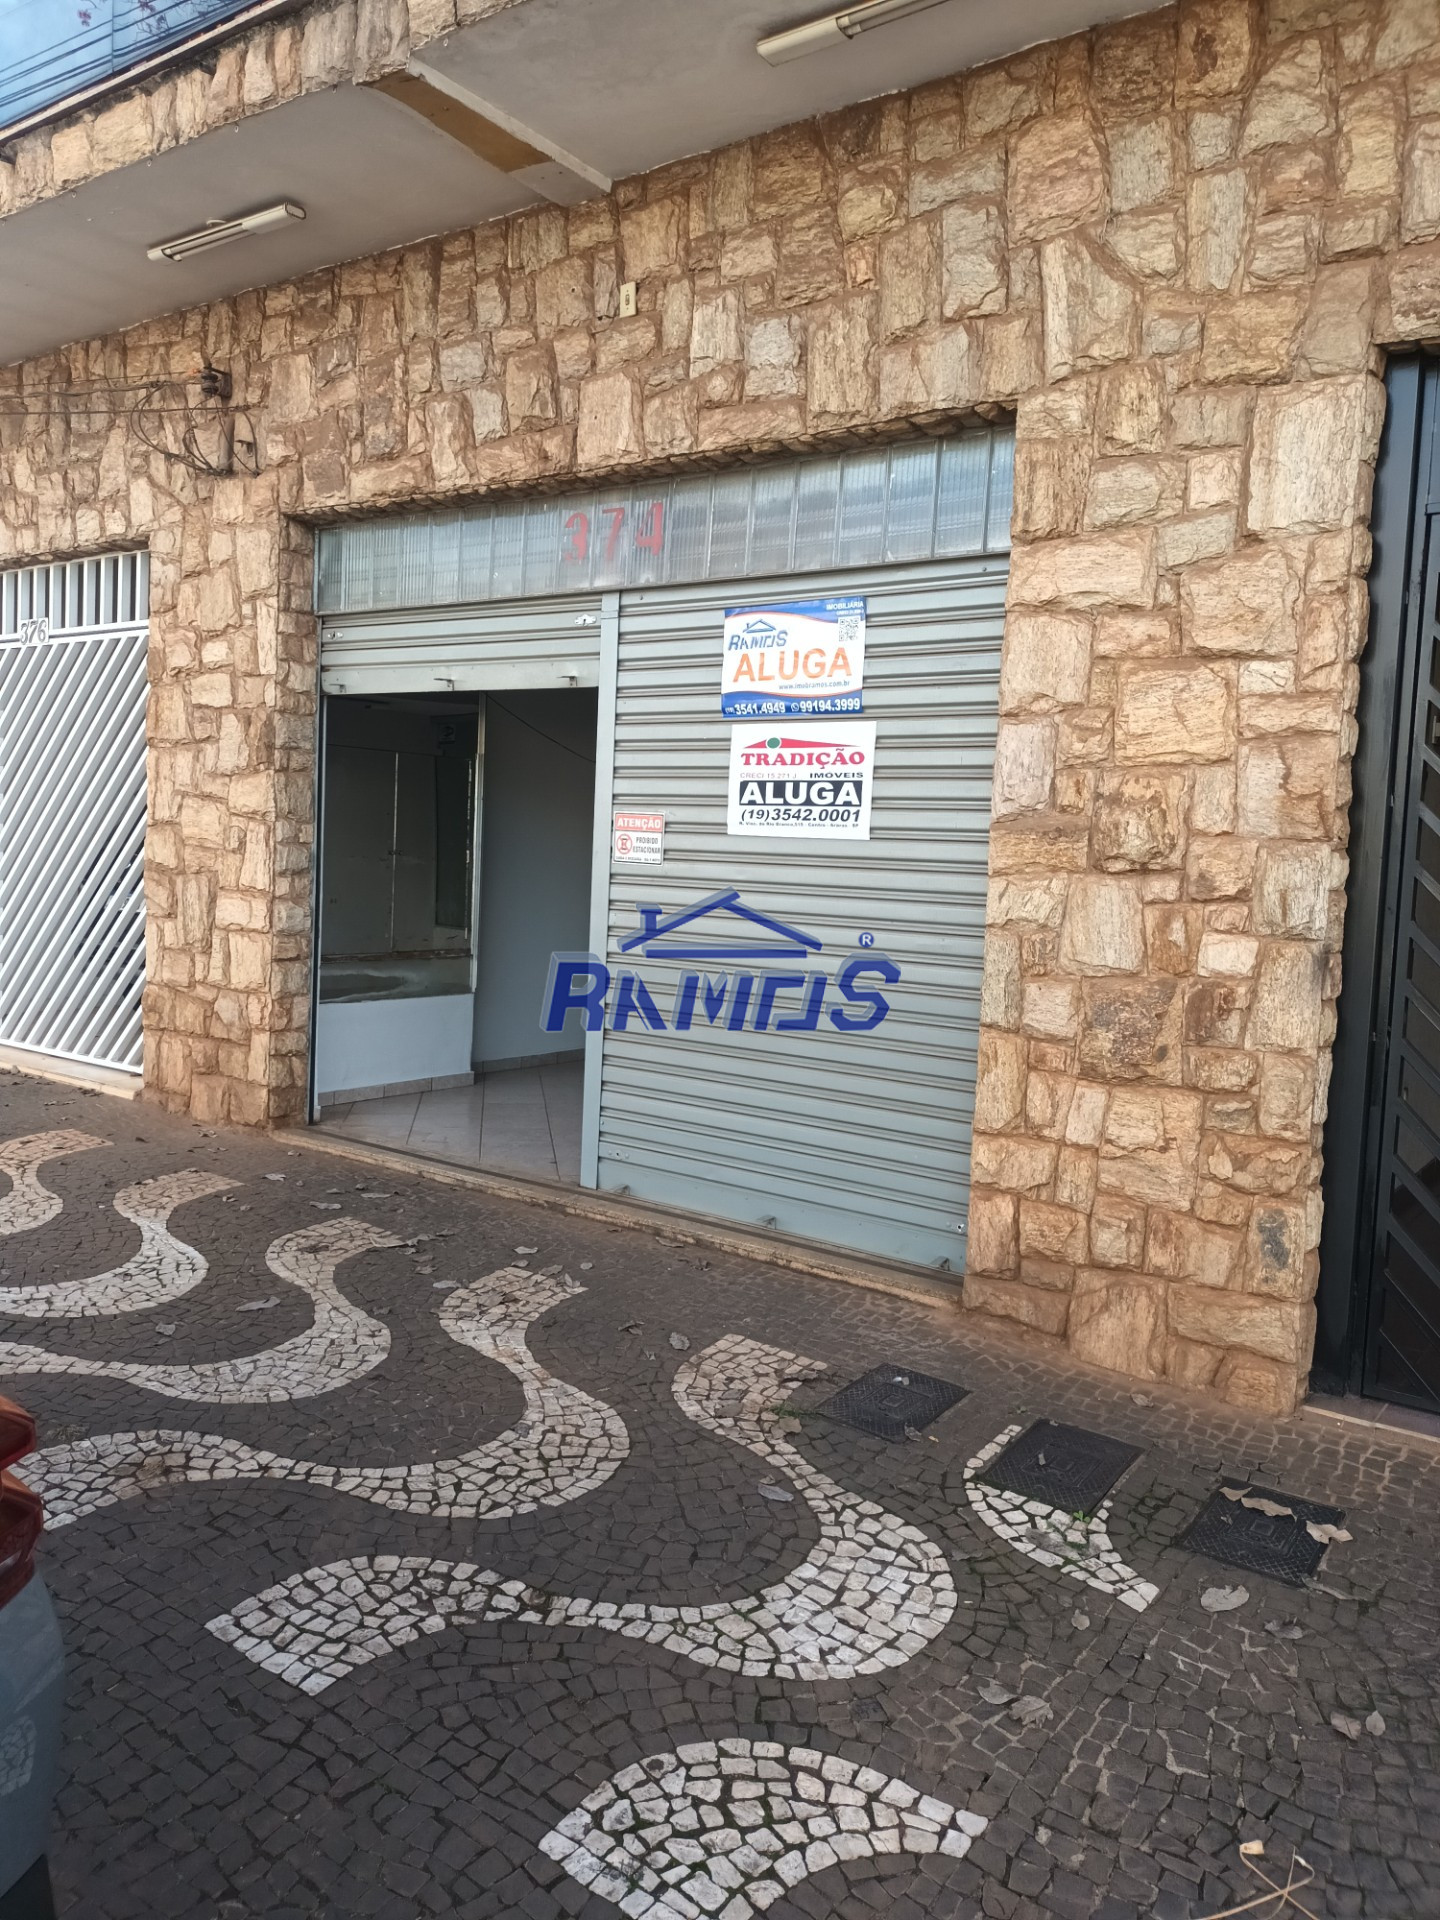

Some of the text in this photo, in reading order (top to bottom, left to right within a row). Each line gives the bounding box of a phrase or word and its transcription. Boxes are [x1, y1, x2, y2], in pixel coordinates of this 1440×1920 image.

[564, 501, 663, 562] 374
[20, 619, 47, 645] 376
[728, 630, 789, 651] RAMOS
[733, 647, 852, 683] ALUGA
[799, 698, 861, 712] 99194.3999
[740, 748, 866, 769] TRADIÇÃO
[740, 781, 860, 805] ALUGA
[617, 817, 661, 830] ATENÇÃO
[741, 808, 861, 822] (19)3542.0001
[632, 846, 661, 854] ESTACIONAR
[636, 836, 659, 844] PROIBIDO
